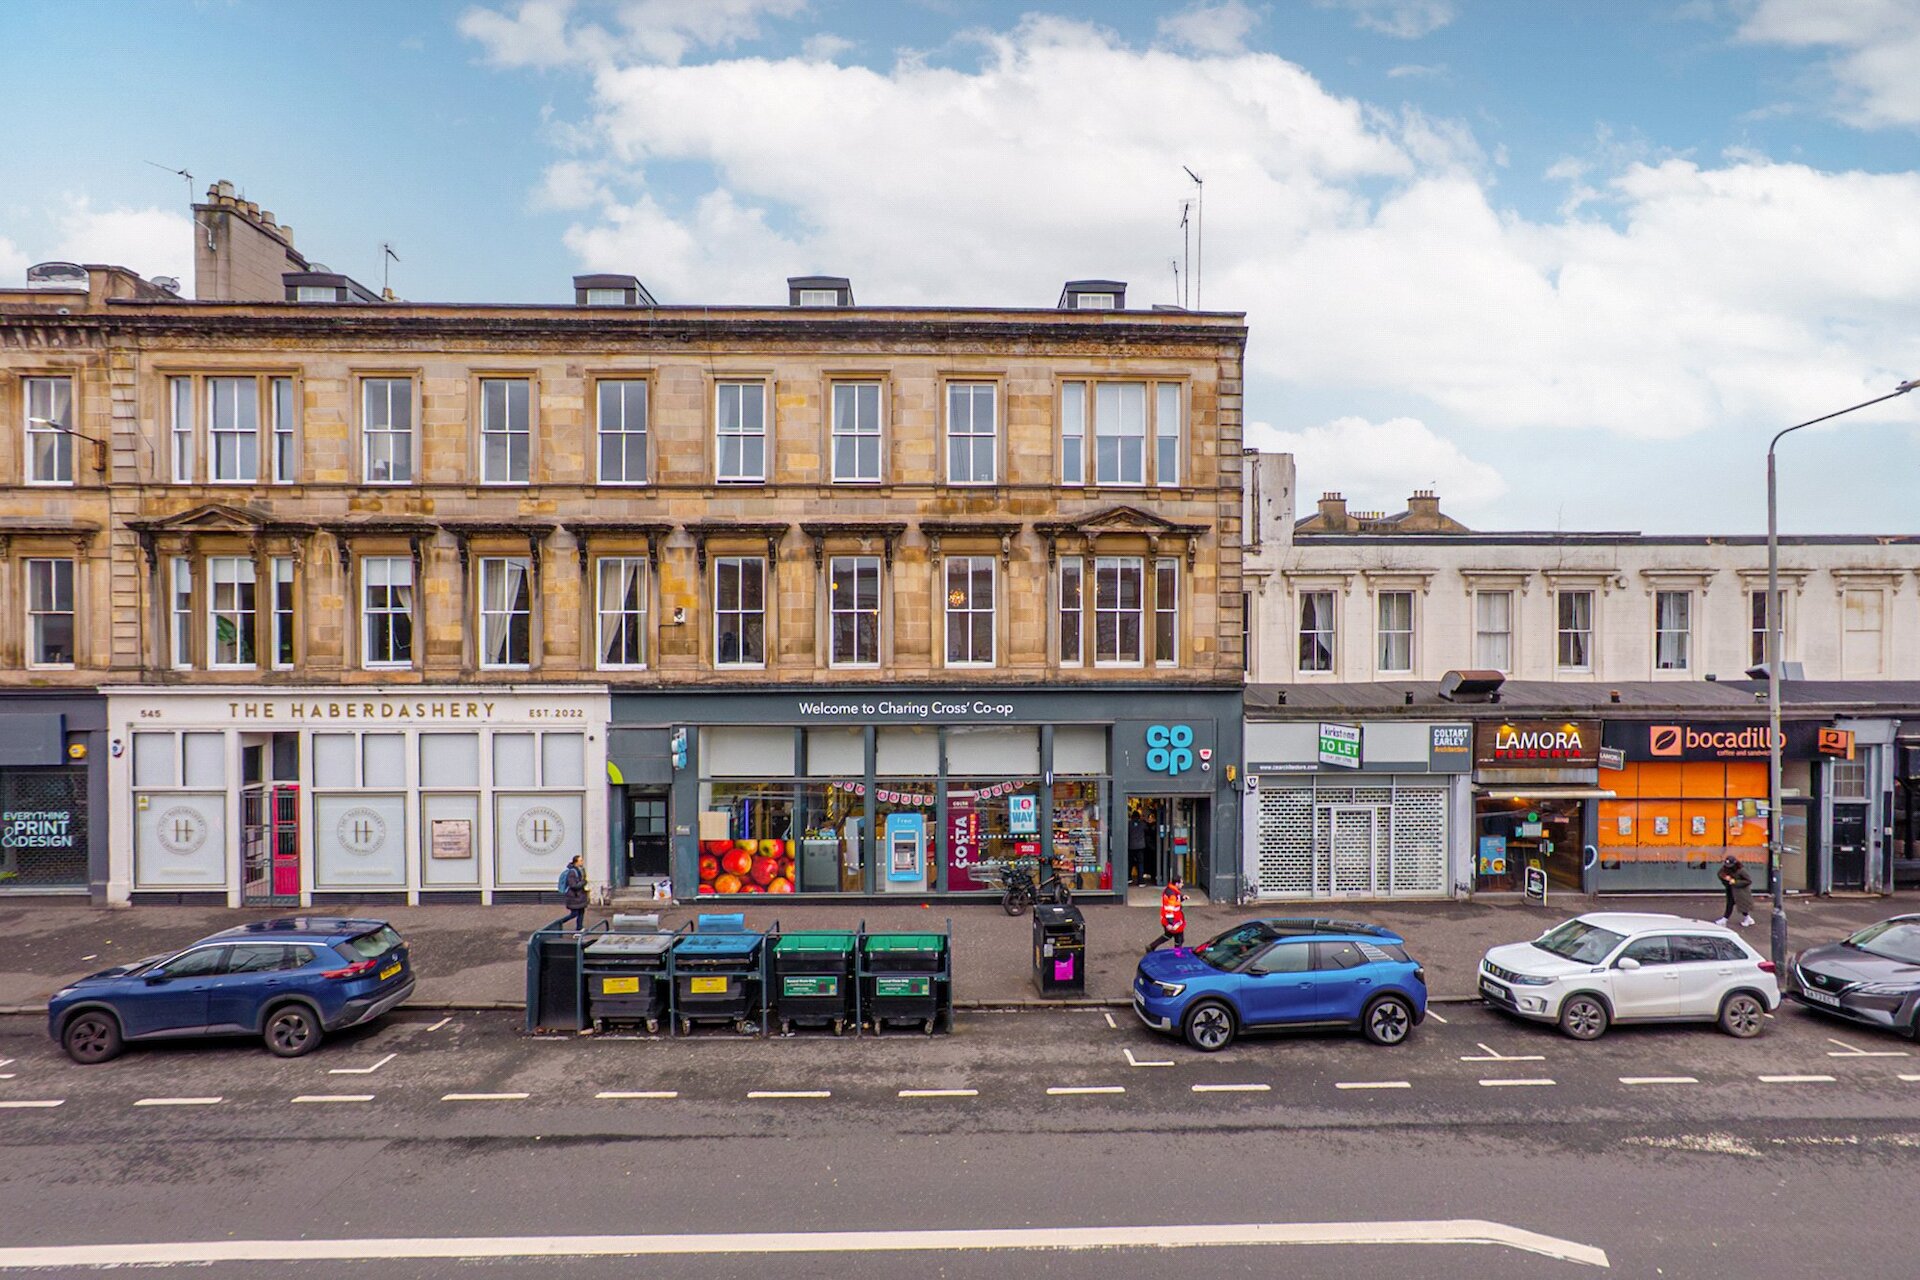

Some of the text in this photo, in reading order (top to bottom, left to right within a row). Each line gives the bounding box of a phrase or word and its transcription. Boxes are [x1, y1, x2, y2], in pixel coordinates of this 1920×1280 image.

[140, 709, 161, 718] 545
[229, 703, 496, 718] THE HABERDASHERY
[799, 702, 858, 714] Welcome
[862, 703, 875, 714] to
[878, 702, 928, 717] Charing
[973, 701, 1013, 716] Co-op
[1434, 729, 1468, 738] COLTART
[1434, 737, 1465, 746] EARLEY
[1495, 732, 1583, 749] LAMORA
[1320, 739, 1359, 756] TO LET
[1495, 749, 1581, 759] PIZZERIA
[3, 811, 70, 821] EVERYTHING
[1012, 811, 1033, 823] WAY
[14, 820, 70, 836] PRINT
[18, 835, 73, 848] DESIGN
[955, 816, 968, 869] COSTA
